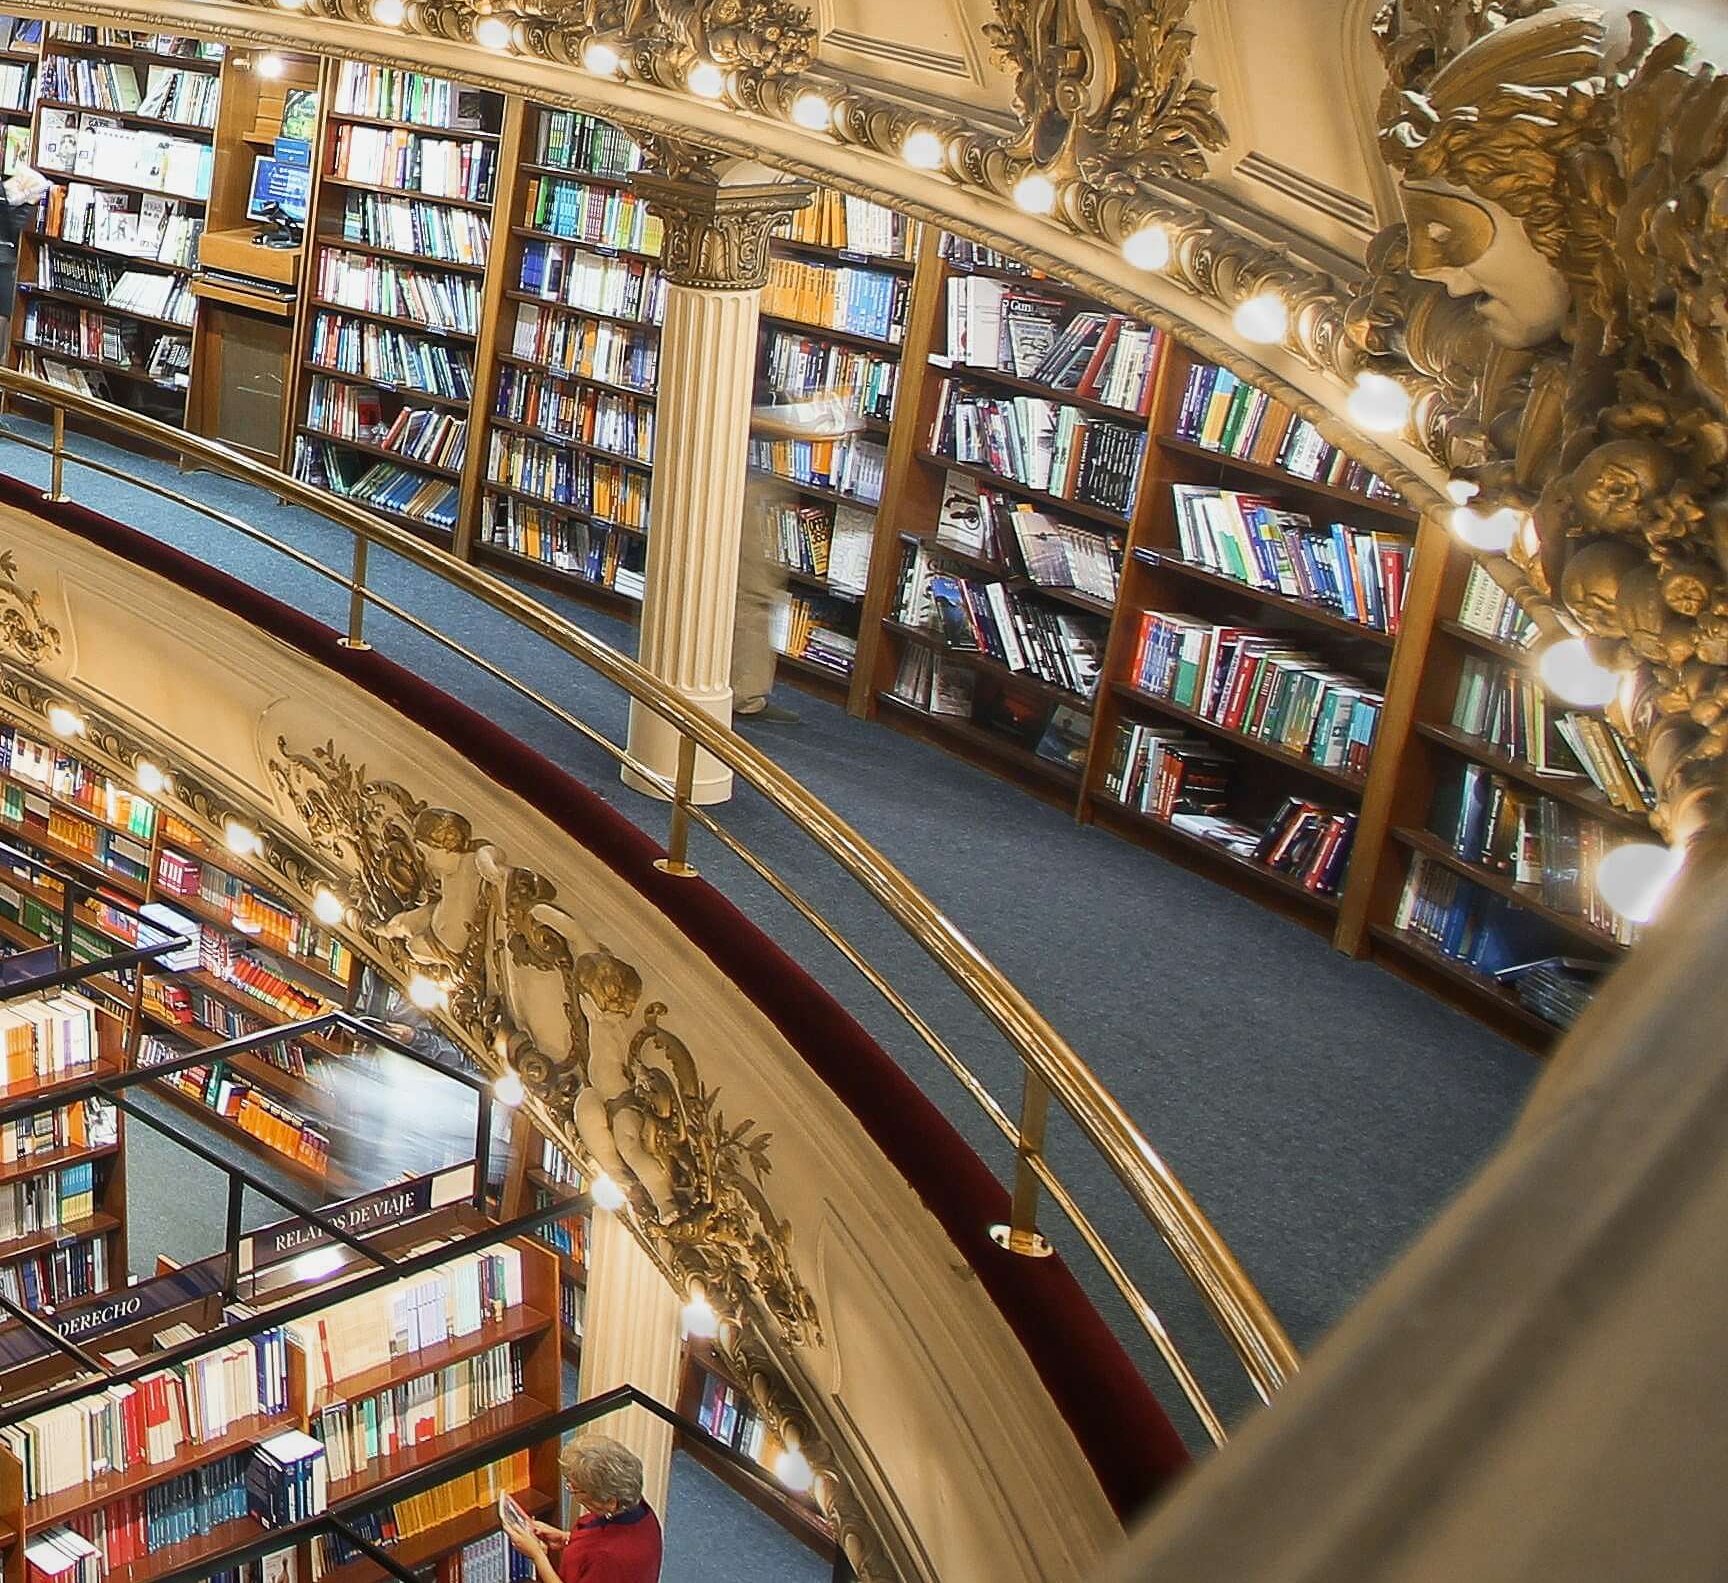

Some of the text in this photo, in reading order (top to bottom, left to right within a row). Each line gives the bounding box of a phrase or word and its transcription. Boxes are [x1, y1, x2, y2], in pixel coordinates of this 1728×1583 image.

[348, 1205, 372, 1228] DE
[373, 1191, 416, 1220] VIAJE
[55, 1296, 142, 1339] DERECHO
